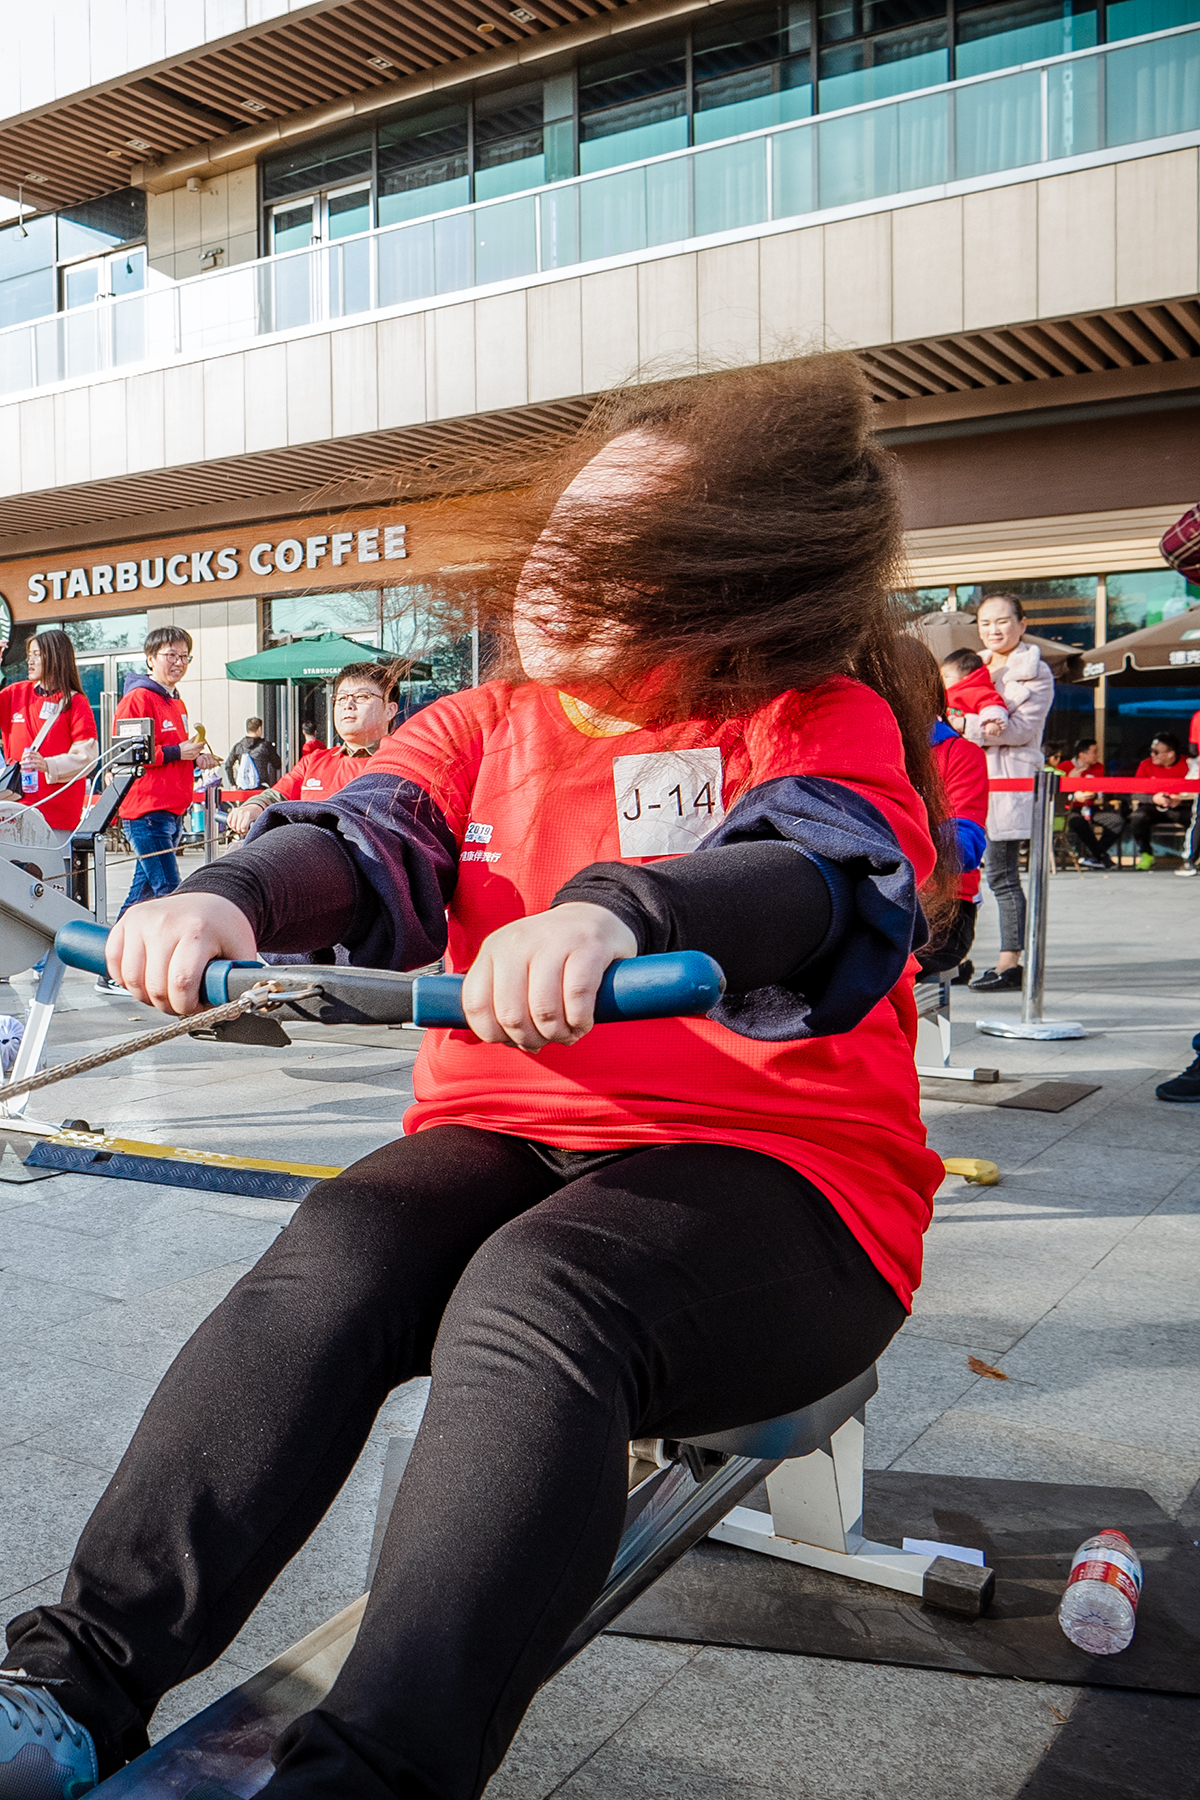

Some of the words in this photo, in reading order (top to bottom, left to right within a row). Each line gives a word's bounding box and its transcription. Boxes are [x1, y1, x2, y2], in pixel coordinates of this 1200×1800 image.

[28, 547, 239, 603] STARBUCKS
[249, 525, 407, 576] COFFEE
[623, 782, 716, 821] J-14
[468, 824, 491, 836] 2019
